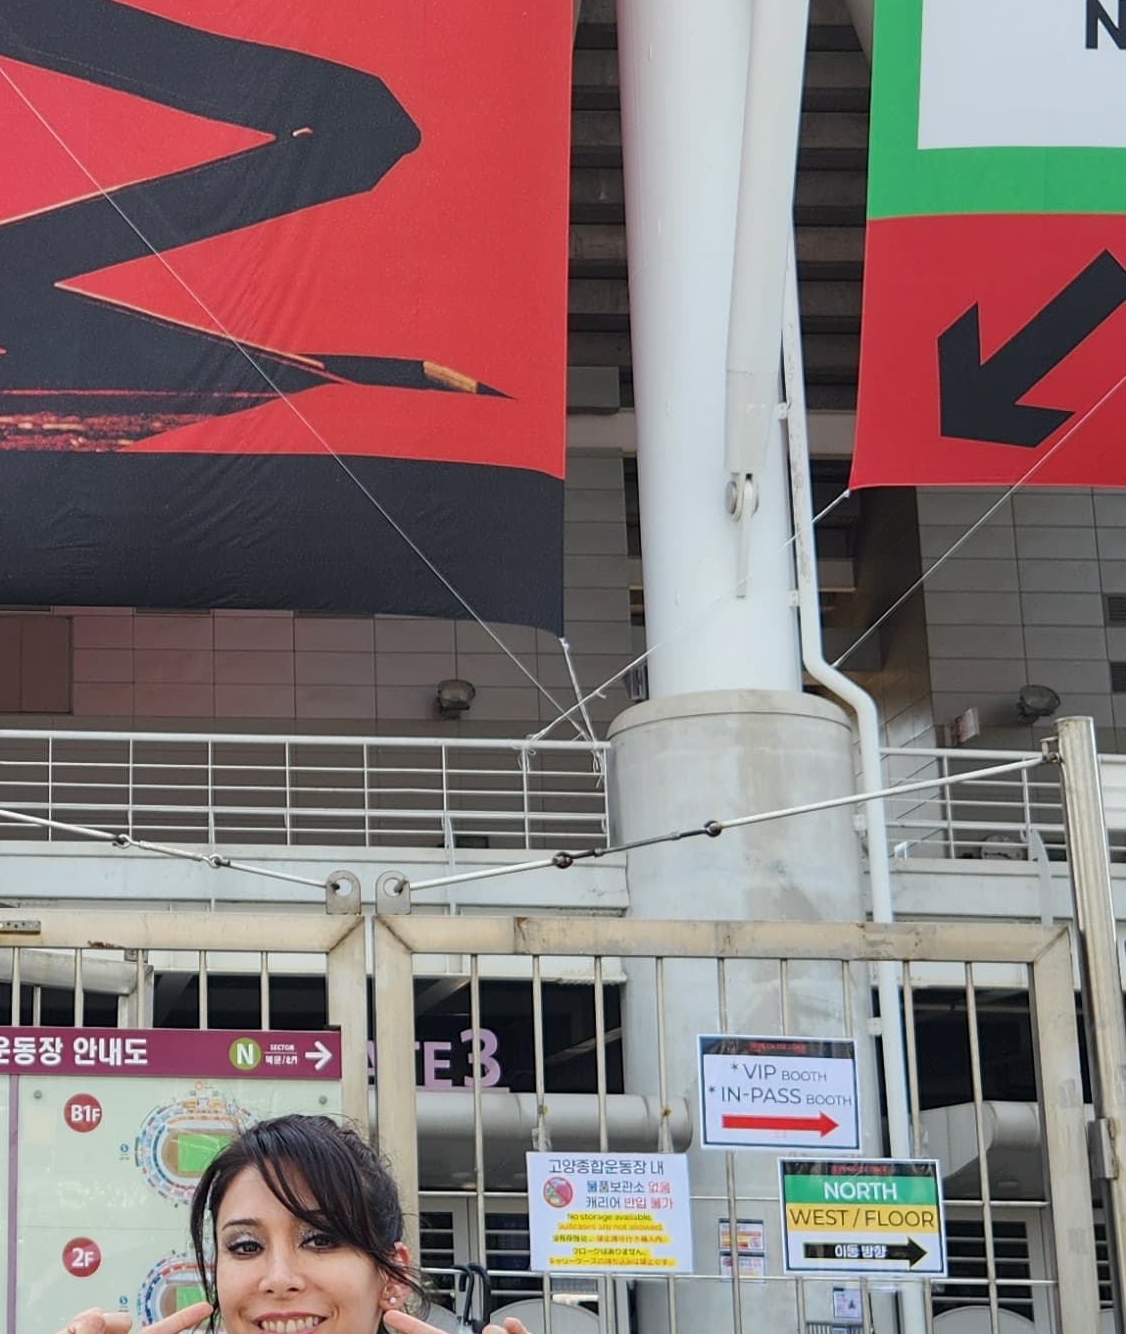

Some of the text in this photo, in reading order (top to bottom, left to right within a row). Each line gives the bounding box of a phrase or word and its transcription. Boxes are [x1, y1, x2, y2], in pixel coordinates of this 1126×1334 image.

[73, 1036, 148, 1067] 안내도
[236, 1043, 254, 1066] N
[270, 1044, 295, 1052] SECTOR
[460, 1028, 501, 1087] 3
[743, 1063, 827, 1082] VIP BOOTH
[721, 1086, 852, 1106] IN-PASS BOOTH
[70, 1104, 101, 1123] B1F
[548, 1159, 664, 1175] 고양종합운동장 내
[824, 1181, 898, 1201] NORTH
[586, 1196, 621, 1210] 캐리어
[624, 1197, 647, 1210] 반입
[580, 1213, 612, 1223] storage
[790, 1208, 849, 1226] WEST
[865, 1210, 934, 1227] FLOOR
[72, 1247, 94, 1268] 2F
[834, 1244, 888, 1259] 이동 방향
